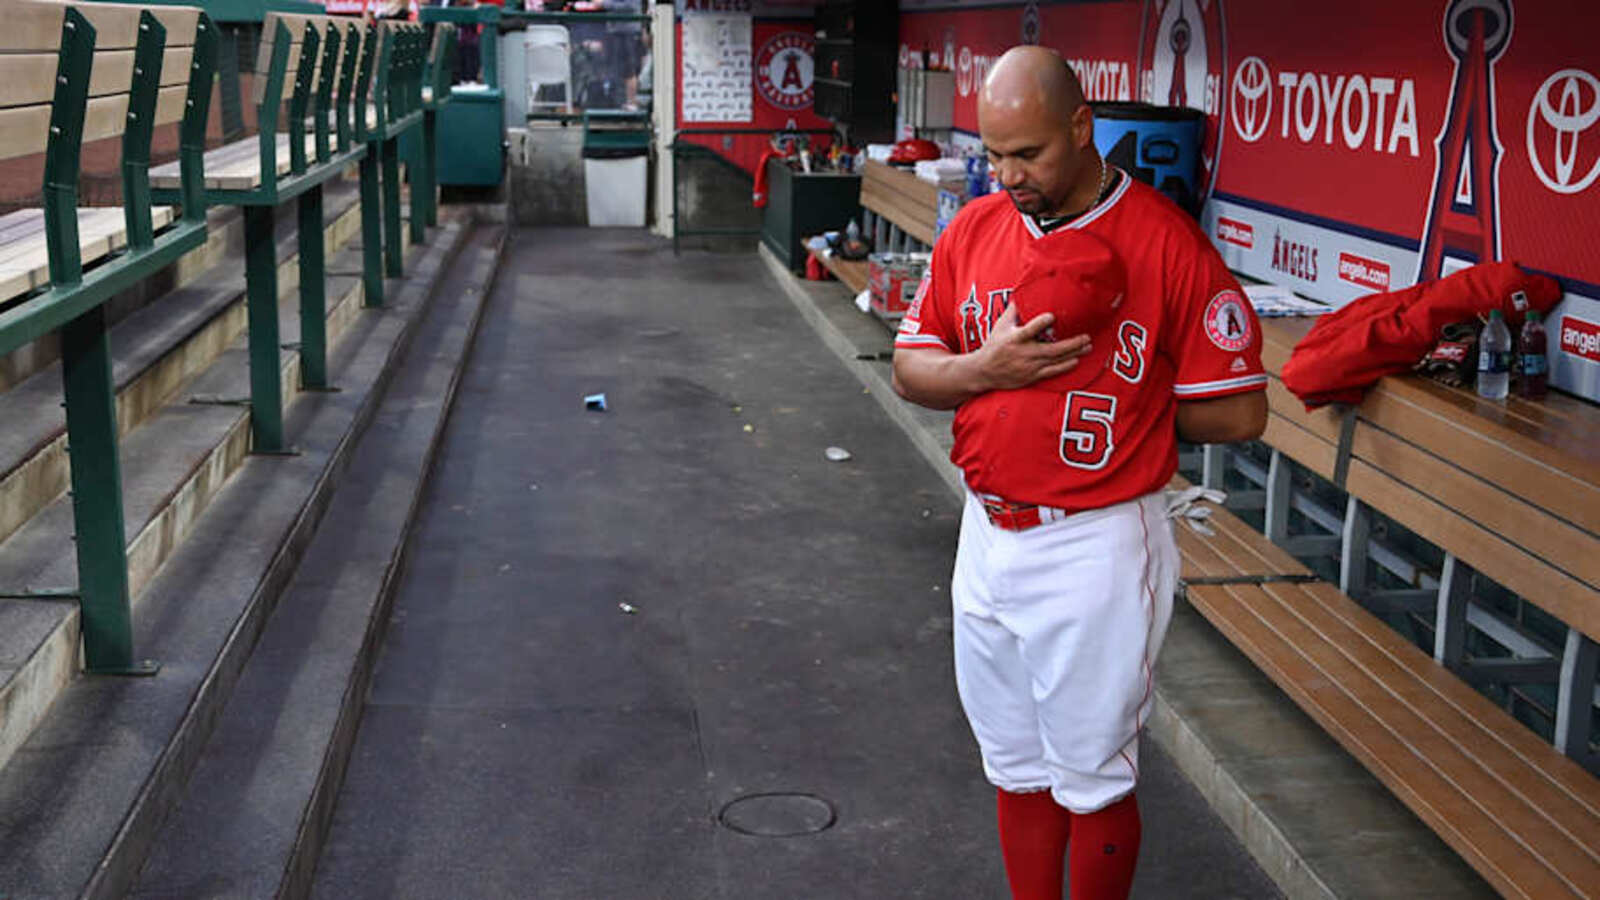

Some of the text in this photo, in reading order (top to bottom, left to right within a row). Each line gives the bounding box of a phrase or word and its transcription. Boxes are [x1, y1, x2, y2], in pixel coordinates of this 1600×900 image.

[1278, 72, 1420, 157] TOYOTA
[1272, 224, 1318, 282] ANGELS
[1339, 259, 1389, 286] angels.com
[1060, 391, 1116, 470] 5
